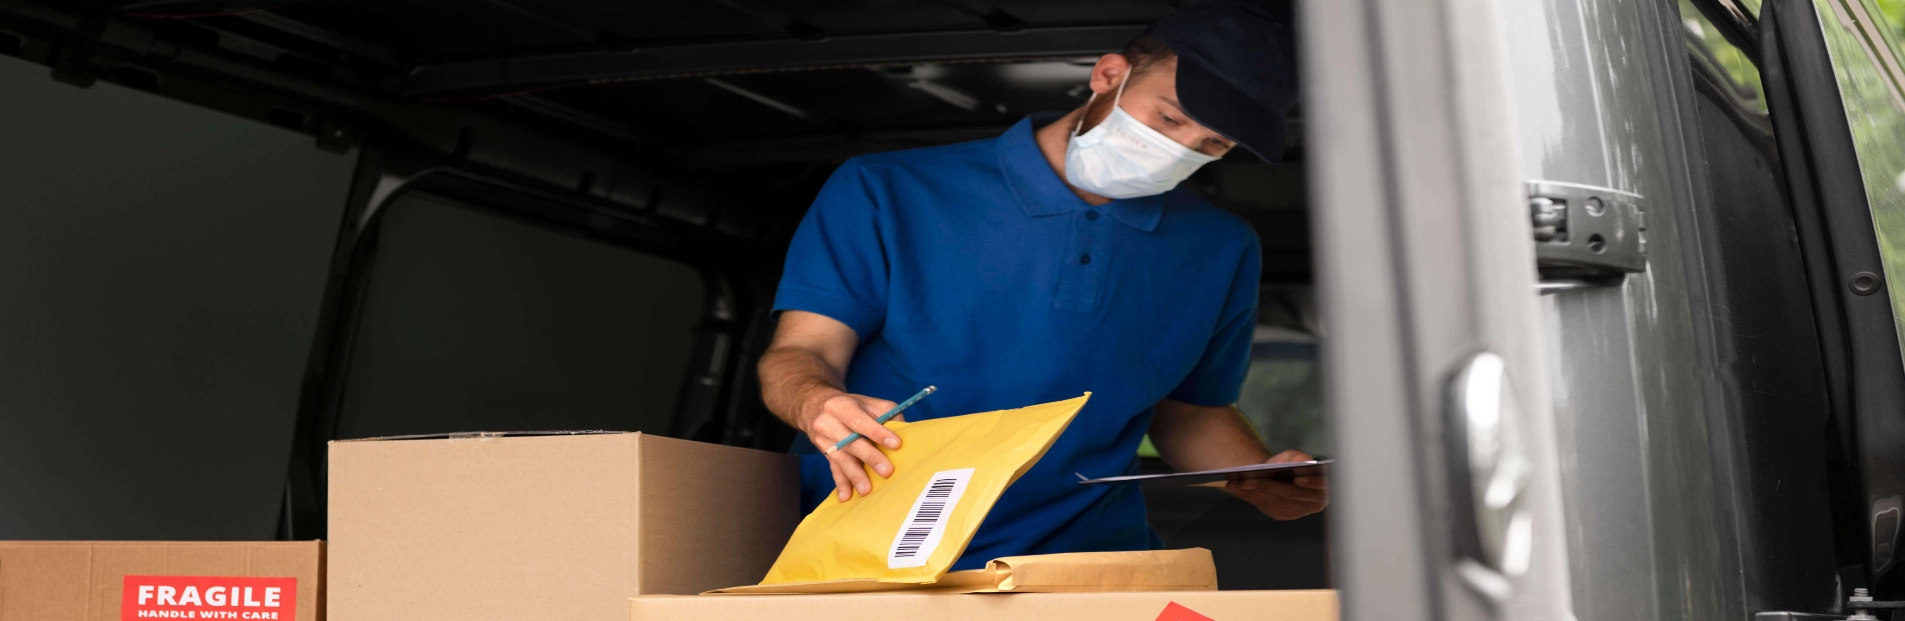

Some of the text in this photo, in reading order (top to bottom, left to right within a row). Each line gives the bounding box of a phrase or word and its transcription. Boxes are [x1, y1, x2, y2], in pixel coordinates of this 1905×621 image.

[137, 585, 281, 607] FRAGILE
[137, 609, 279, 620] HANDLE WITH CARE
